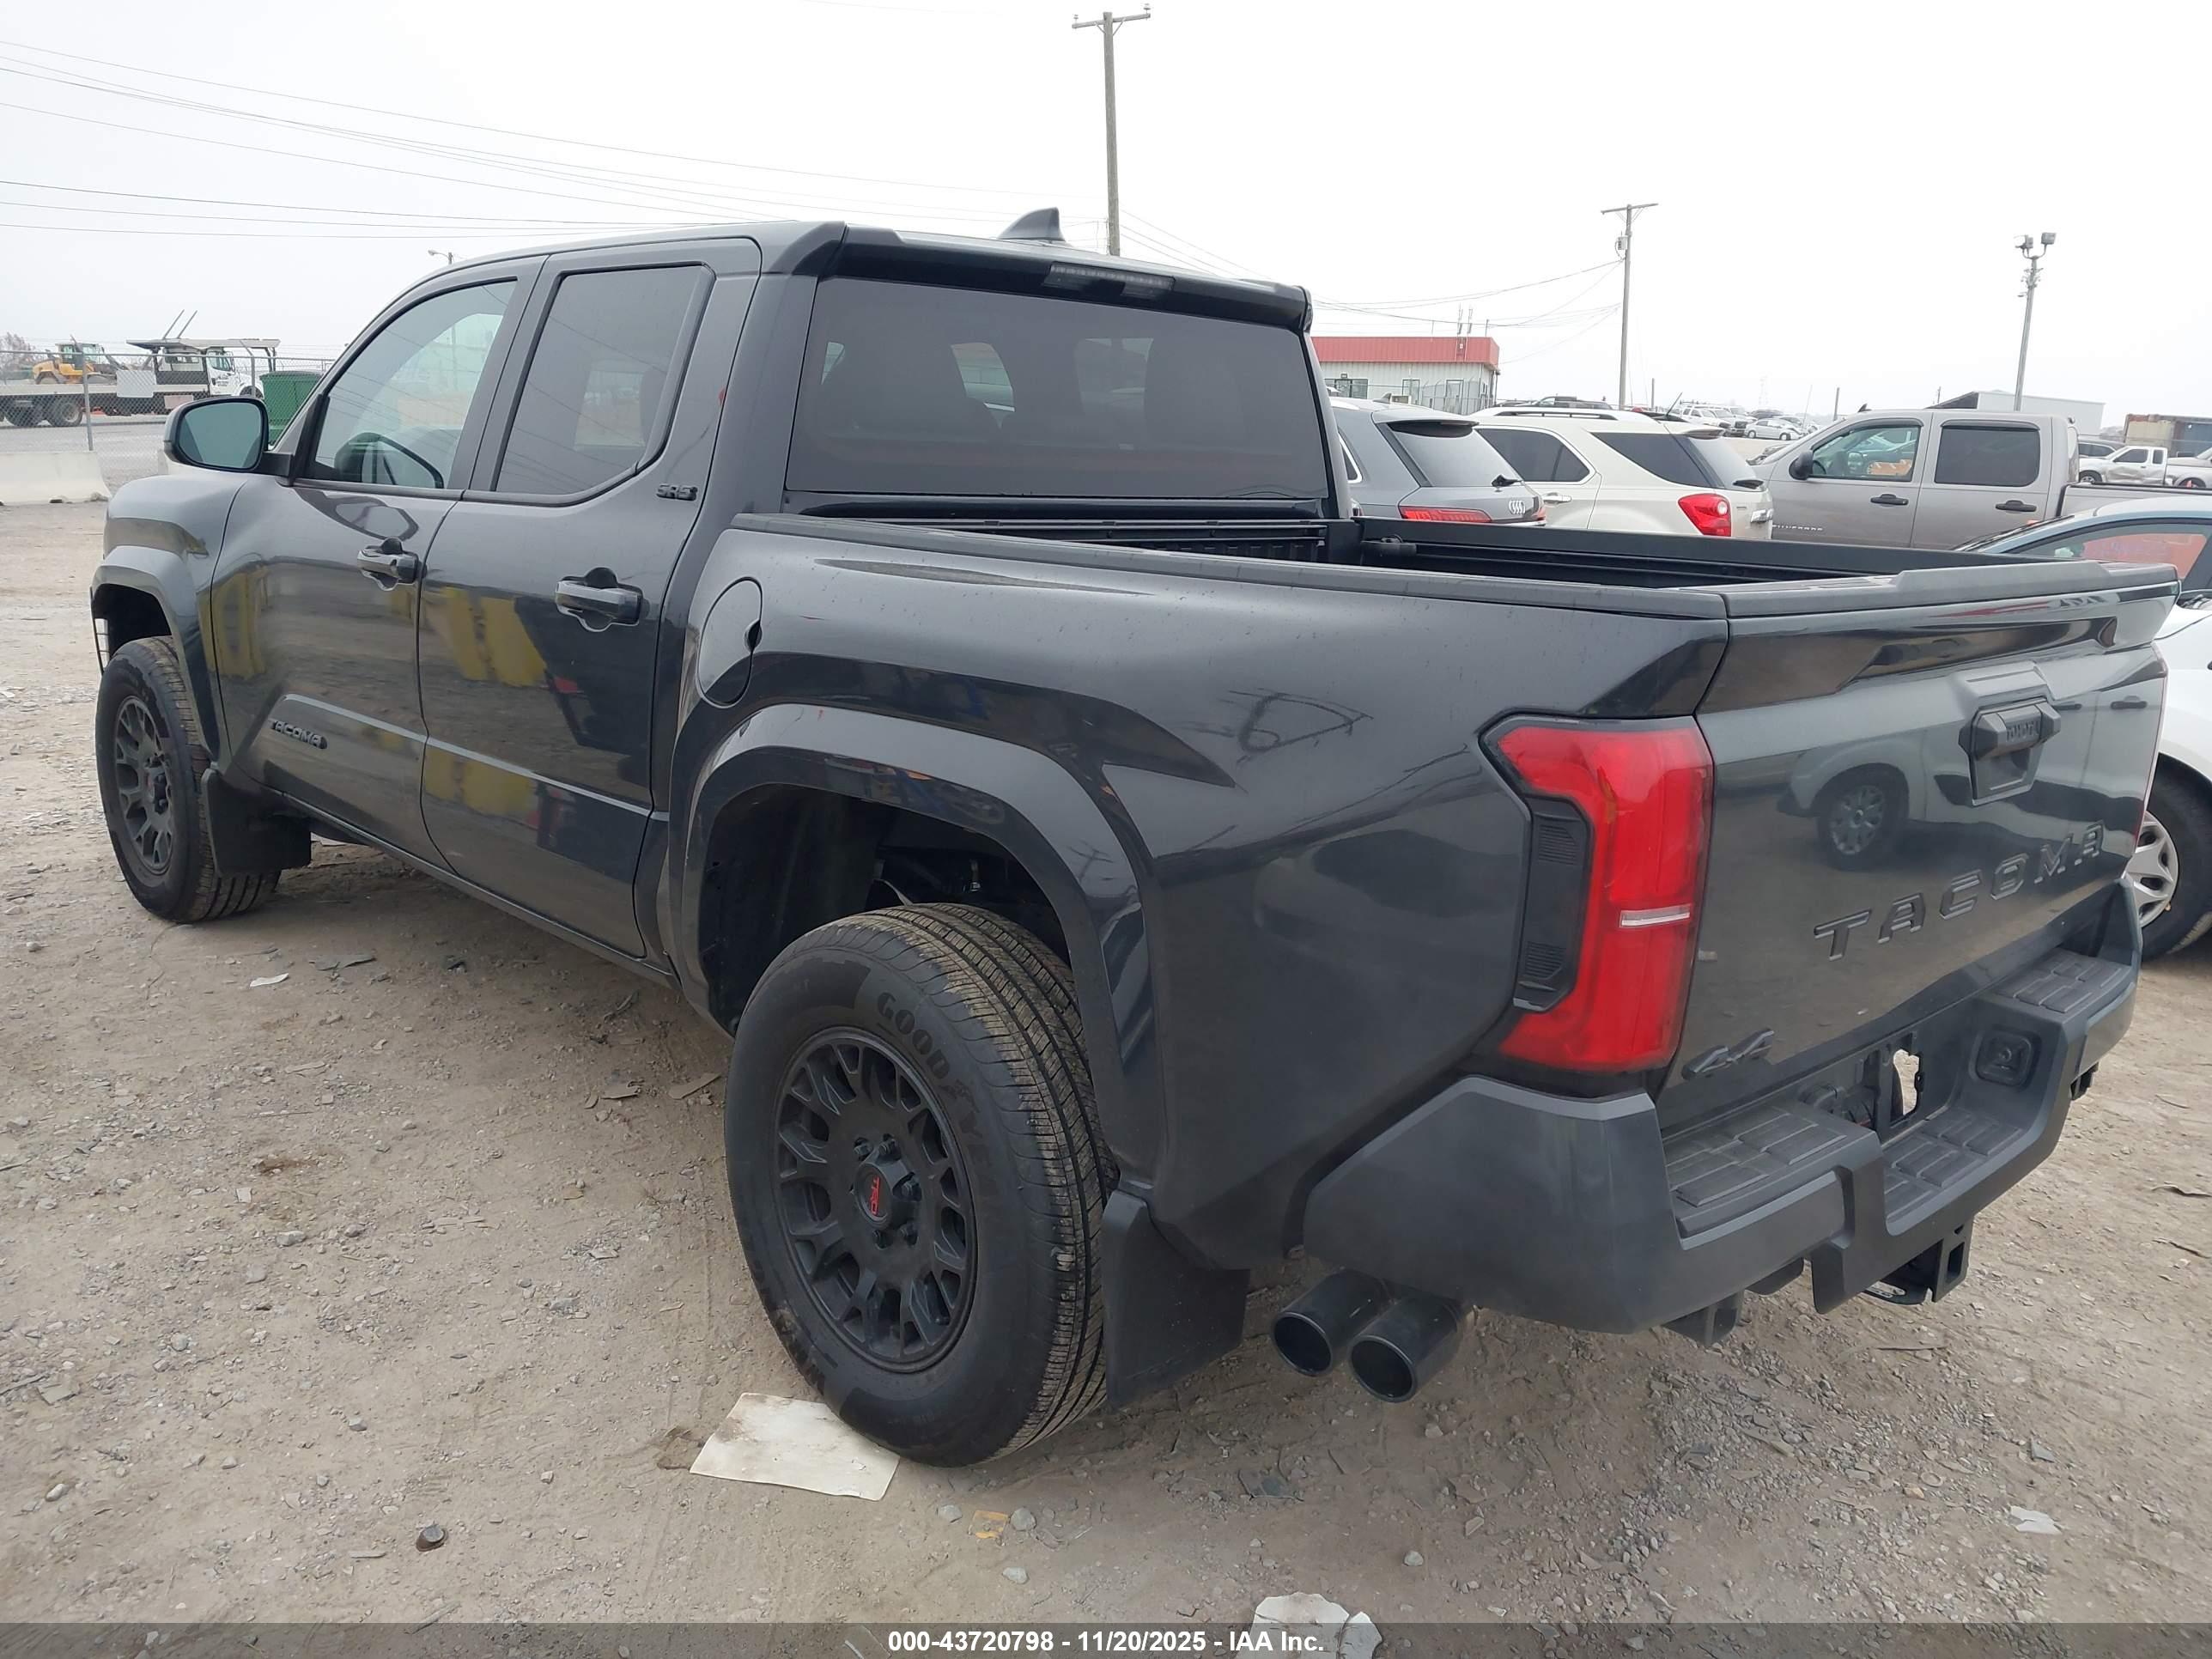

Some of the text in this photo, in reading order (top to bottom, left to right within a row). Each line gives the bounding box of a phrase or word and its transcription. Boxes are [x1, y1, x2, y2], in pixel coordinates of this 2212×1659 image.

[269, 718, 328, 750] TACOMA
[1814, 820, 2104, 962] TACOMA
[869, 1175, 880, 1216] TRD
